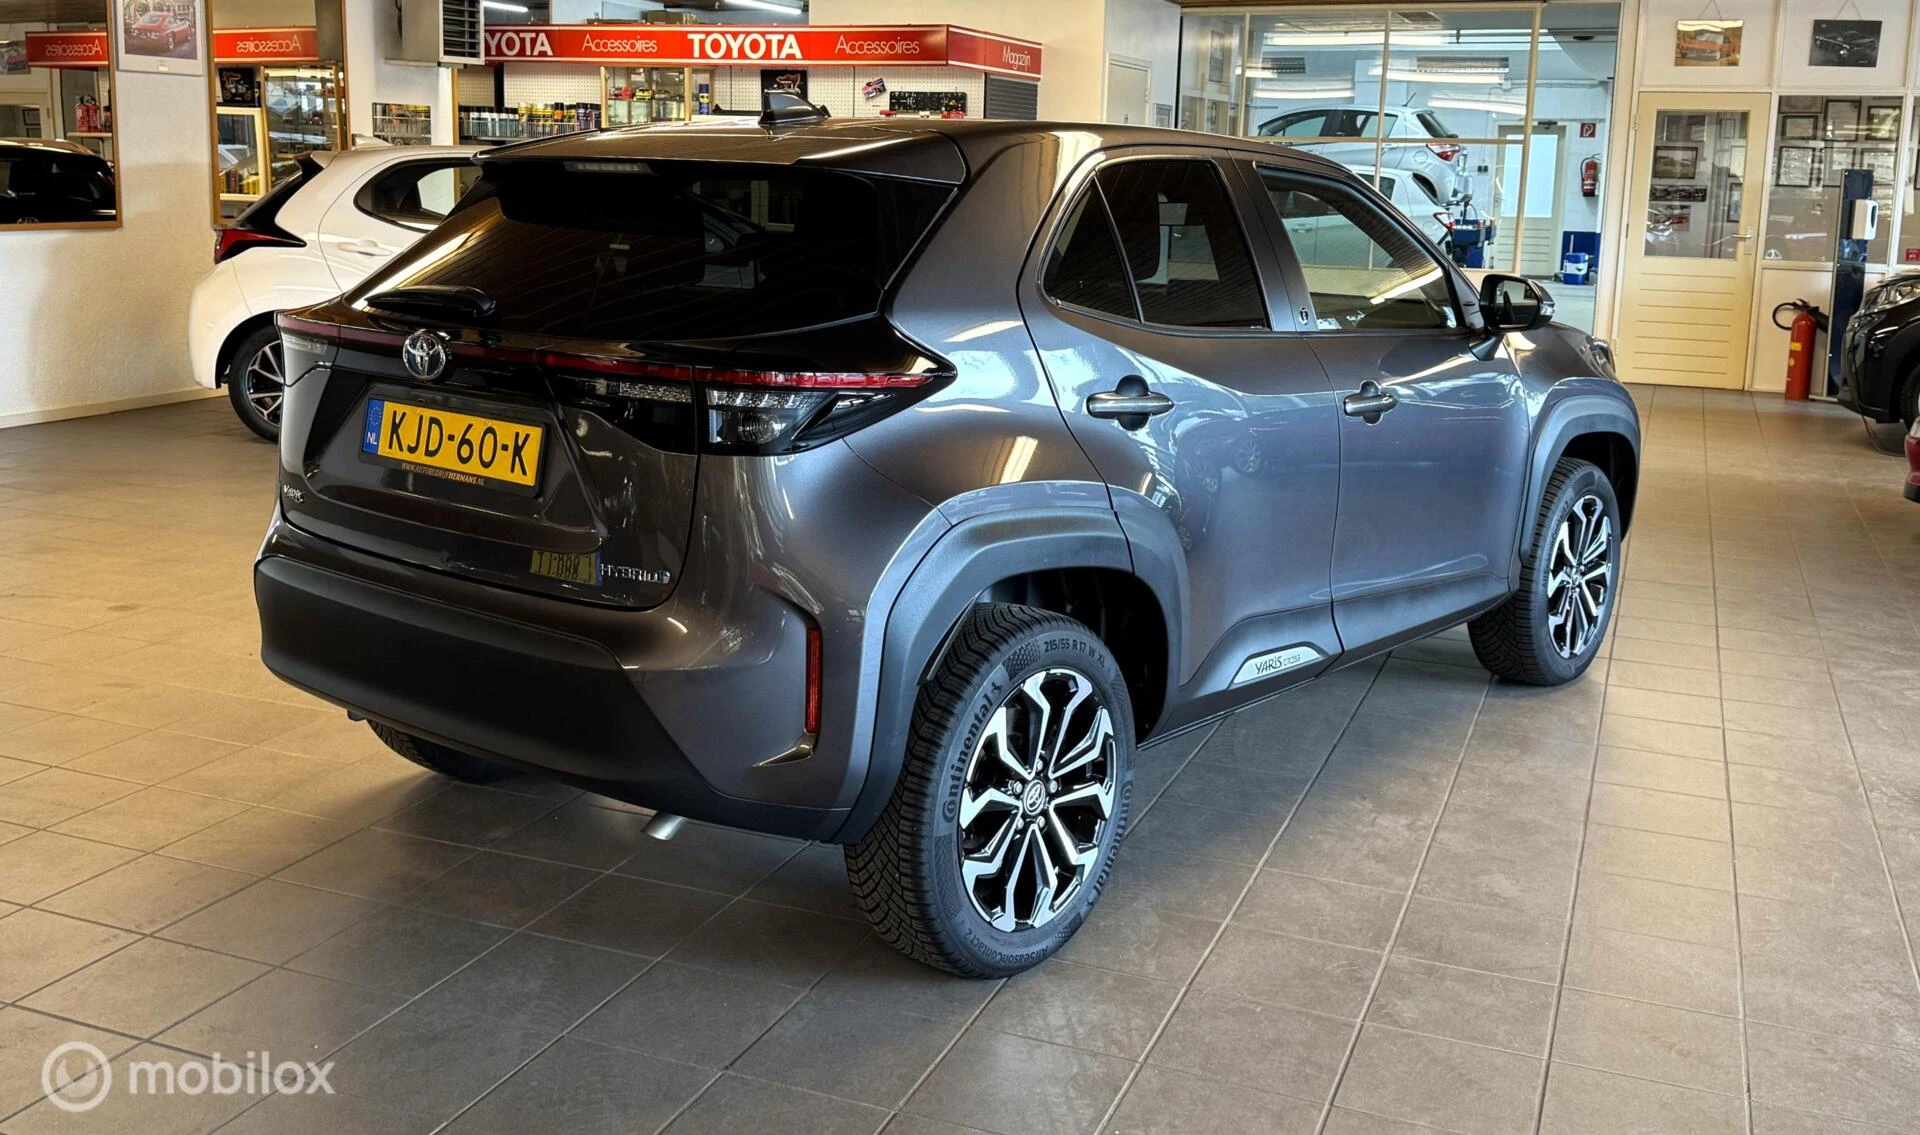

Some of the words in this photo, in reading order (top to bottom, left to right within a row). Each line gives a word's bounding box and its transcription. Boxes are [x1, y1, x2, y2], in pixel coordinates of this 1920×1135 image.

[485, 32, 553, 56] YOTA
[582, 33, 658, 53] Accessoires
[687, 33, 803, 59] TOYOTA
[834, 35, 920, 55] Accessoires
[1002, 45, 1031, 72] Magazijn
[366, 431, 378, 445] NL
[388, 410, 531, 477] KJD-60-K
[1043, 638, 1071, 653] 215/55
[1072, 640, 1078, 651] R
[1080, 640, 1087, 653] 17
[942, 692, 994, 823] Continental
[1093, 780, 1134, 896] Continental
